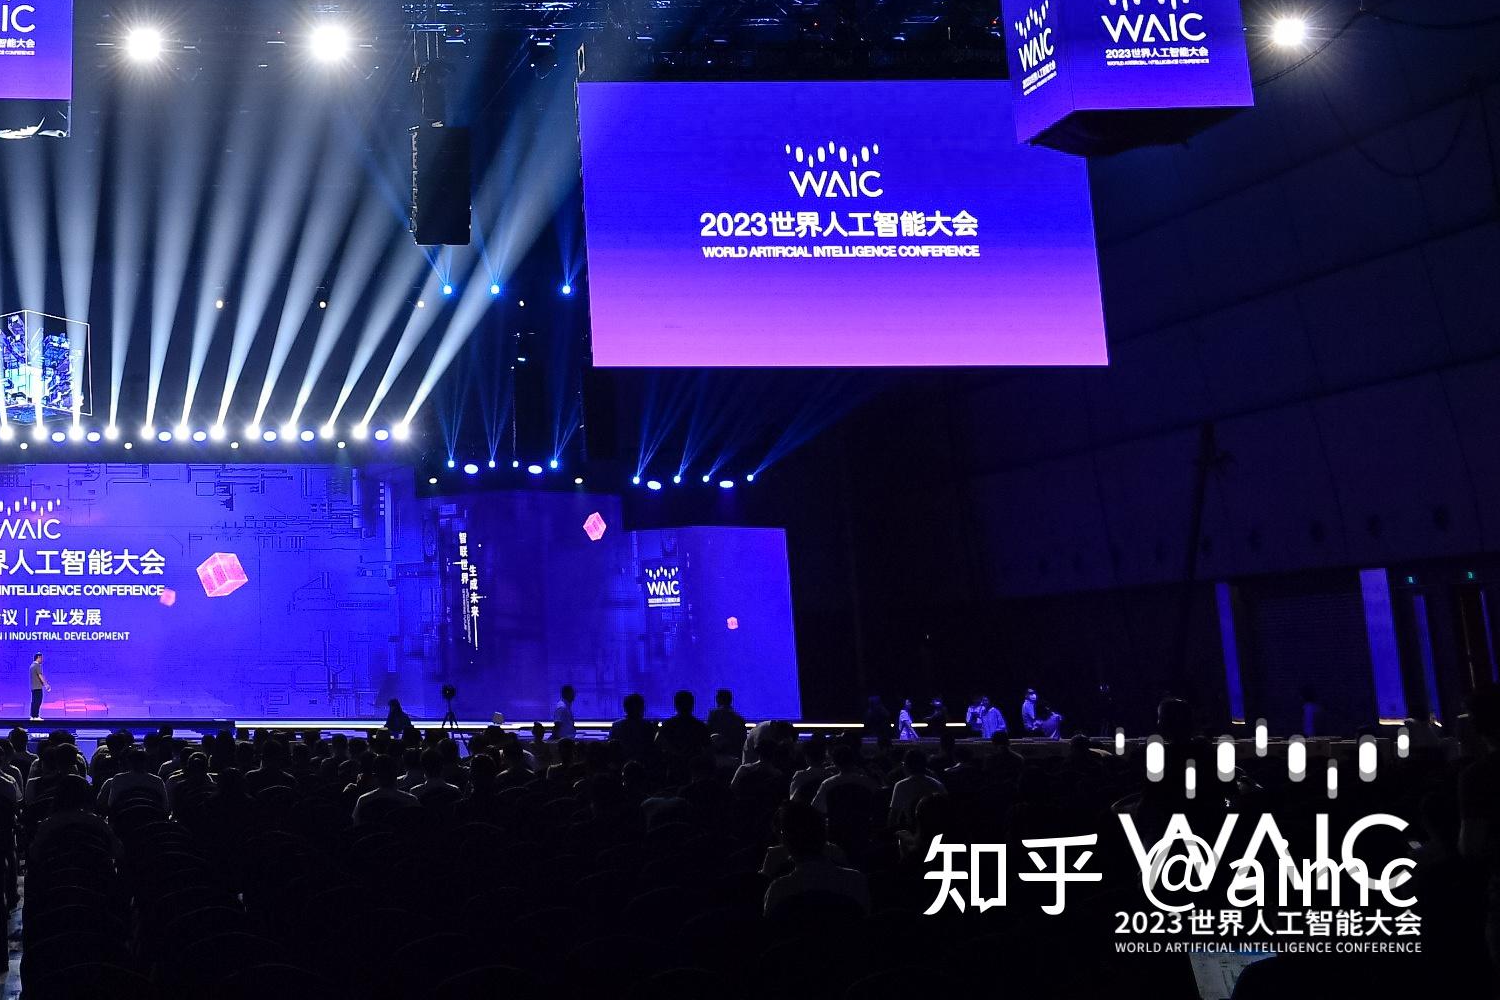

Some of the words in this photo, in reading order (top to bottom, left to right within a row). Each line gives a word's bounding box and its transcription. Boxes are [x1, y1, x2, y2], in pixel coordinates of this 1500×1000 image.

[1101, 12, 1207, 43] WAIC
[1018, 28, 1054, 73] WAIC
[789, 170, 884, 198] WAIC
[699, 209, 979, 238] 2023世界人工智能大会
[702, 245, 748, 258] WORLD
[749, 245, 812, 258] ARTIFICIAL
[813, 245, 897, 257] INTELLIGENCE
[898, 245, 980, 257] CONFERENCE
[0, 585, 81, 596] INTELLIGENCE
[83, 585, 165, 596] CONFERENCE
[646, 580, 680, 596] WAIC
[34, 608, 102, 626] 产业发展
[9, 631, 62, 641] INDUSTRIAL
[64, 631, 130, 641] DEVELOPMENT
